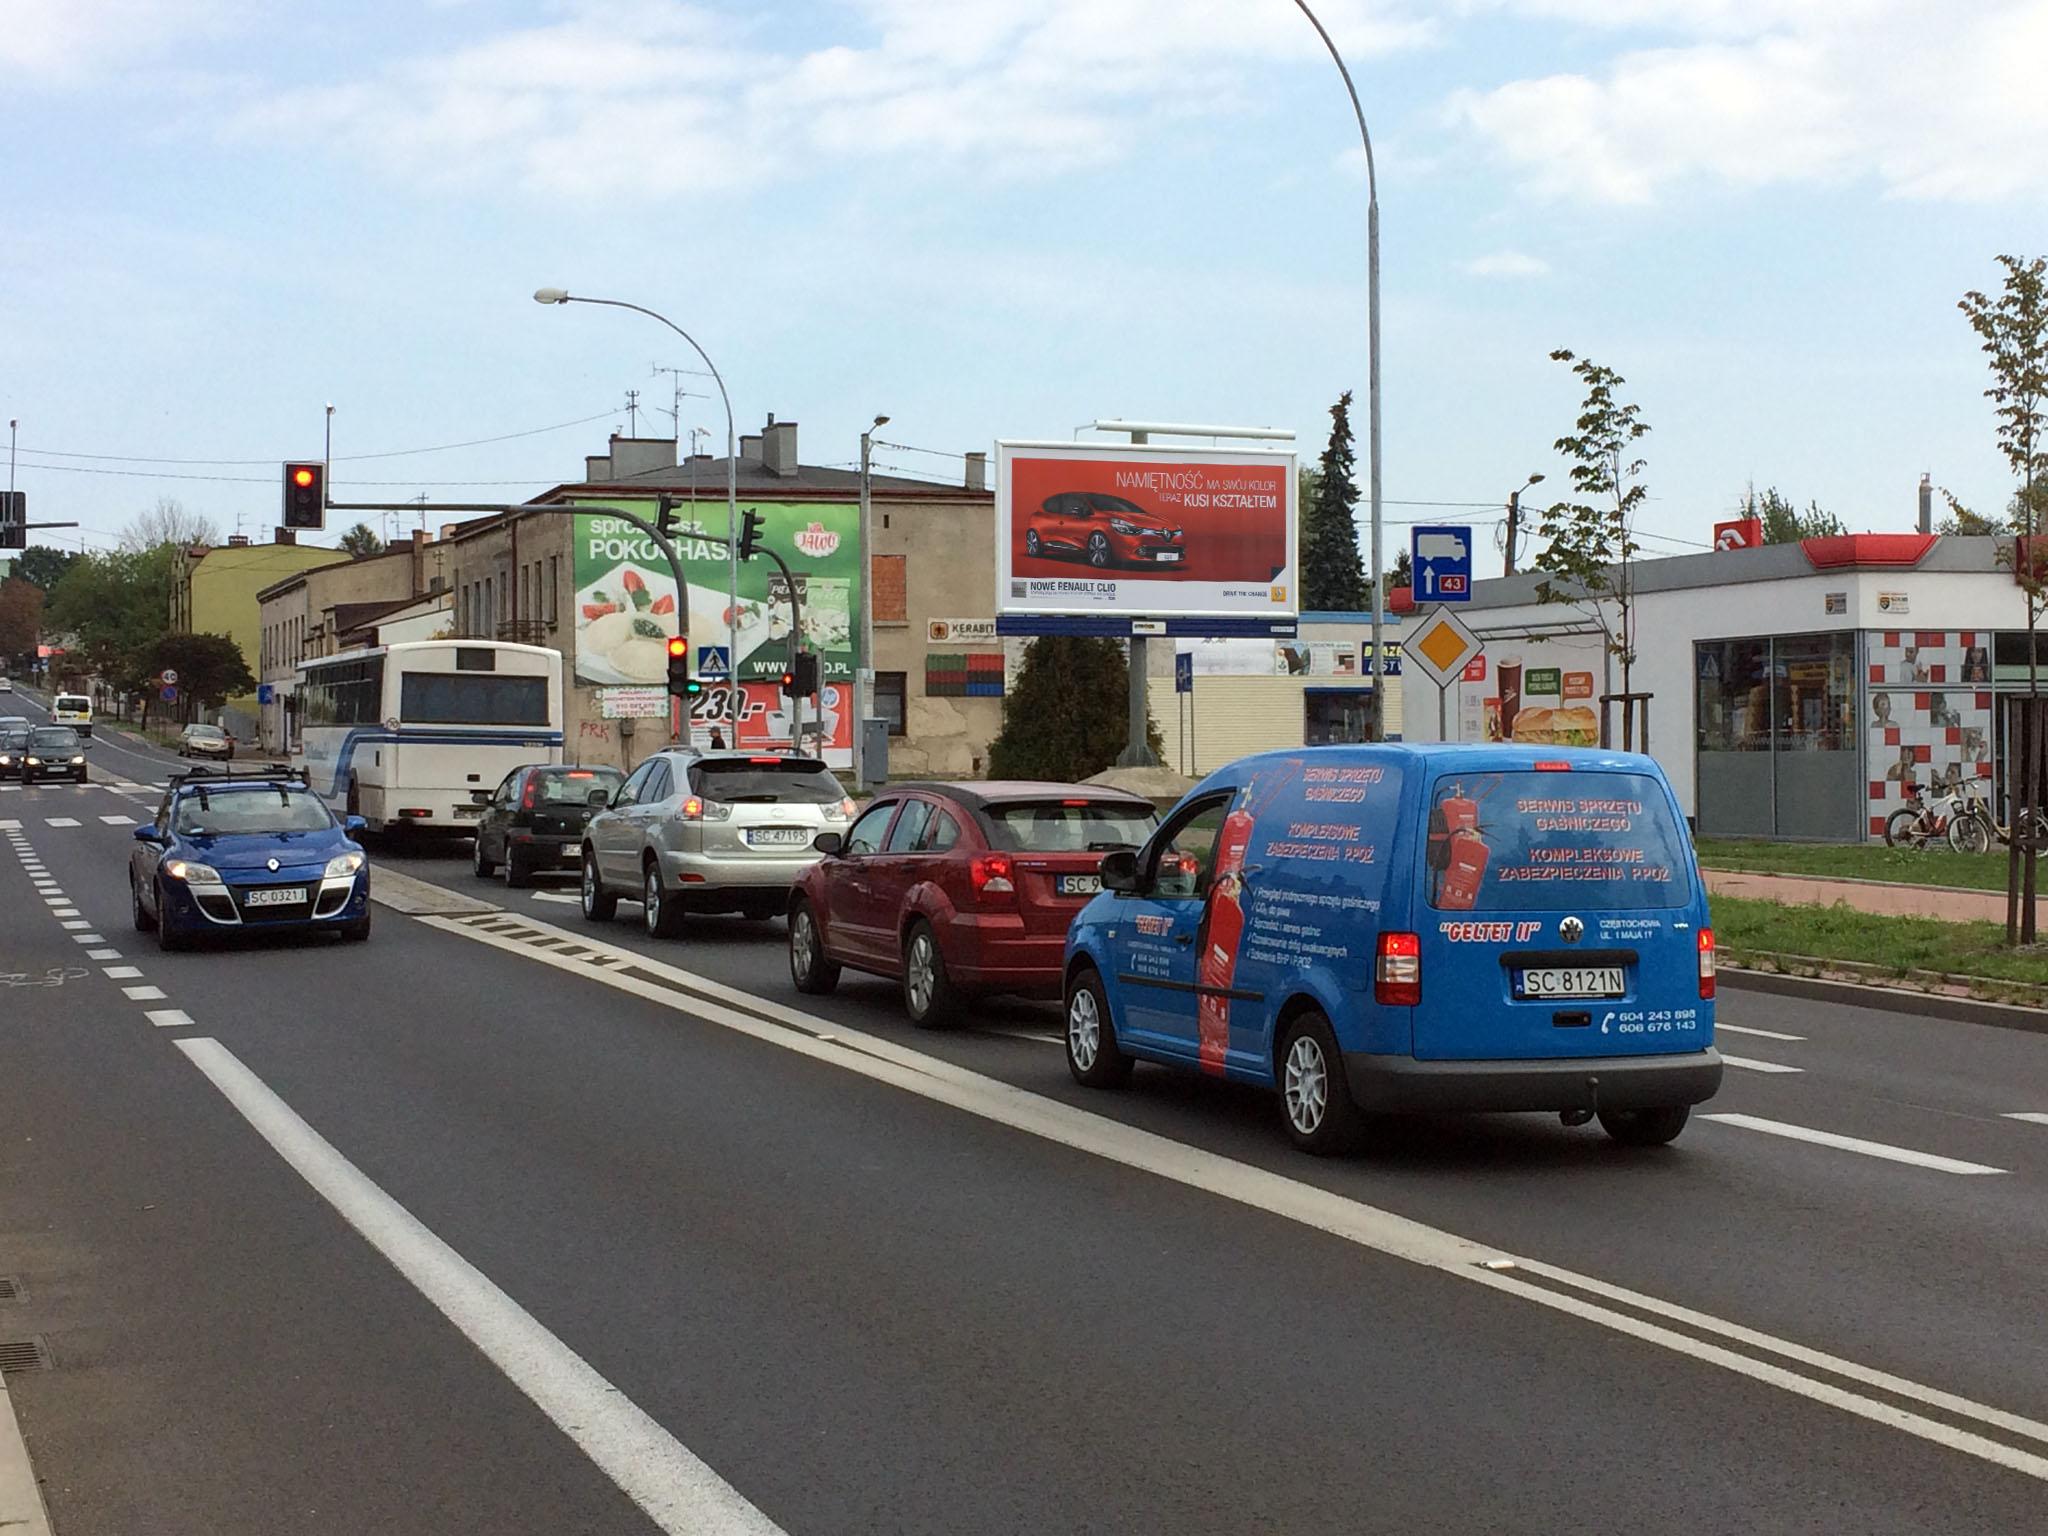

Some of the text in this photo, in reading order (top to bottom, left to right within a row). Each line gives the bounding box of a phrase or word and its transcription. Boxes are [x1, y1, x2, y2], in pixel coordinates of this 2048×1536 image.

[1116, 470, 1277, 493] NAMIĘTNOŚĆ MA SWÓJ KOLOR
[1184, 494, 1209, 507] KUSI
[1212, 495, 1277, 508] KSZTAŁTEM
[1030, 582, 1116, 592] NOWE RENAULT CLIO
[1444, 578, 1461, 590] 43
[952, 624, 995, 633] KERABIT
[1517, 799, 1642, 816] SERWIS SPRZĘTU
[1536, 815, 1631, 832] GAŚNICZEGO
[756, 831, 770, 841] SC
[1529, 849, 1645, 863] KOMPLEKSOWE
[1498, 867, 1626, 881] ZABEZPIECZENIA
[1066, 878, 1086, 892] SC
[251, 890, 305, 904] SC 0321J
[1600, 920, 1661, 929] CZĘSTOCHOWA
[1621, 931, 1643, 939] MAJA
[1527, 970, 1621, 992] SC 8121N
[1619, 1012, 1643, 1021] 604
[1647, 1011, 1671, 1020] 243
[1647, 1022, 1671, 1031] 676
[1676, 1021, 1696, 1030] 143
